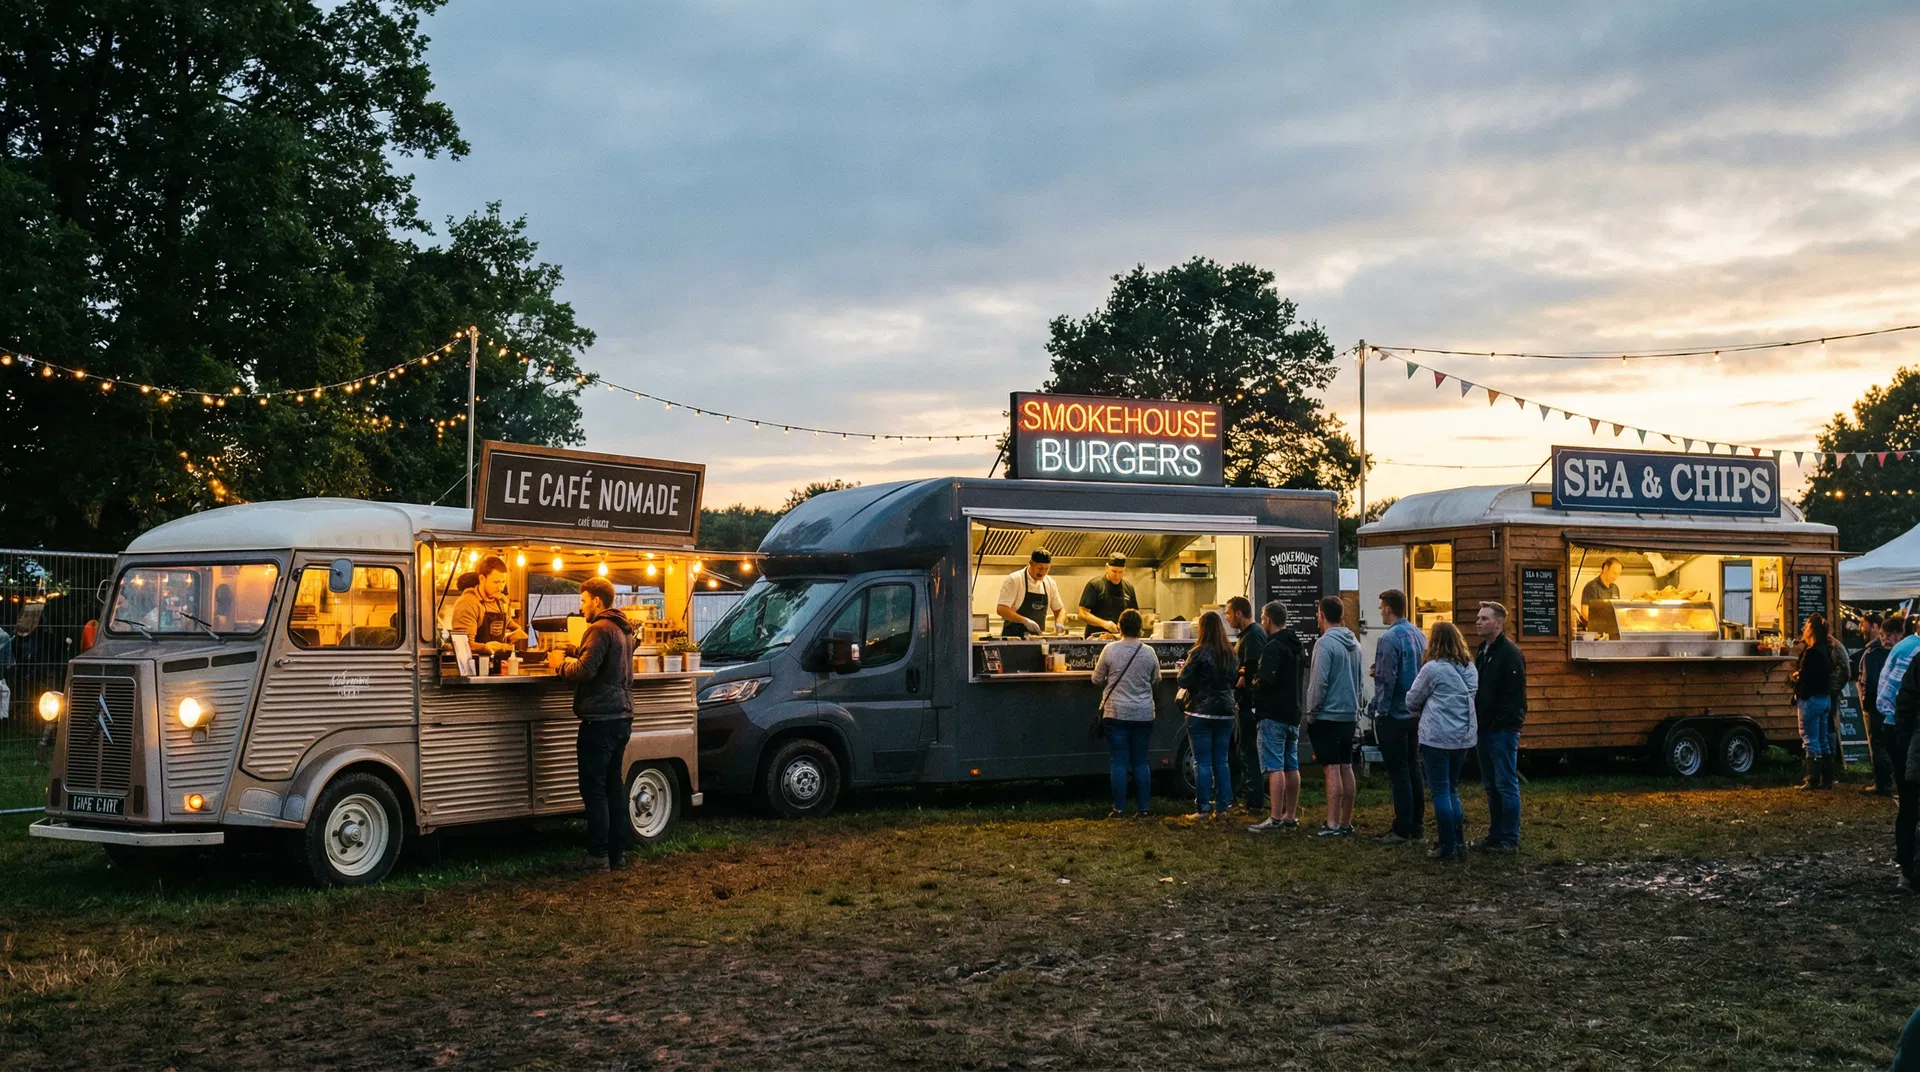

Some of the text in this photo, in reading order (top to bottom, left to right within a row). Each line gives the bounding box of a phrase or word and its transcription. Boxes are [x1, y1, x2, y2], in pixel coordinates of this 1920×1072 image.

[1022, 400, 1217, 438] SMOKEHOUSE
[1041, 437, 1202, 477] BURGERS
[504, 469, 681, 516] LE CAFÉ NOMADE
[1563, 457, 1772, 505] SEA & CHIPS
[1270, 551, 1320, 567] SMOKEHOUSE
[1278, 563, 1311, 575] BURGERS
